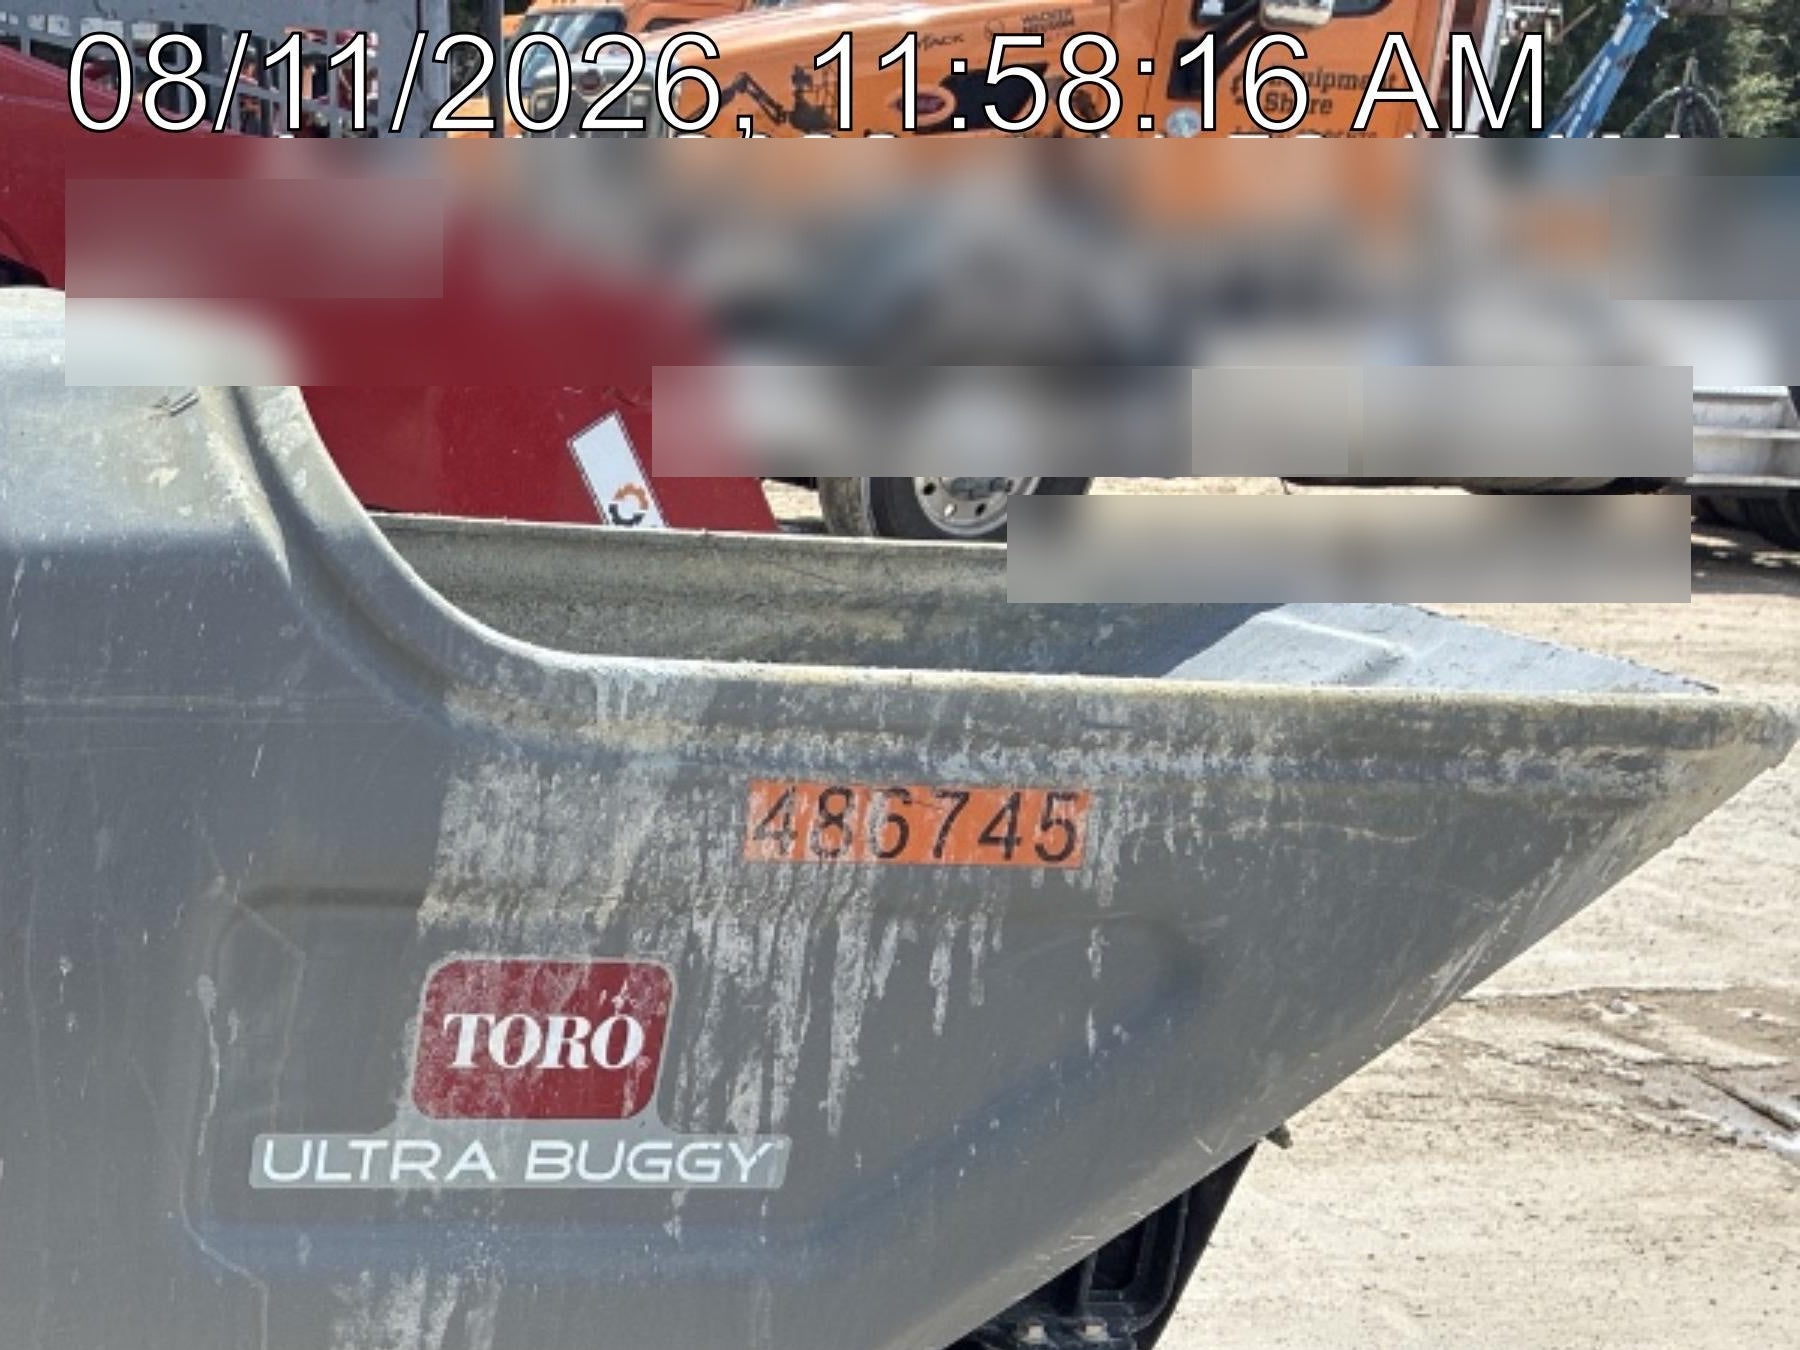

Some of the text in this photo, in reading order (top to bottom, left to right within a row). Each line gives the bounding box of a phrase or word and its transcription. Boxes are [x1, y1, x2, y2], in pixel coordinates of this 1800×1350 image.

[751, 784, 1079, 863] 486745
[443, 1011, 646, 1071] TORO
[261, 1139, 774, 1184] ULTRA BUGGY
